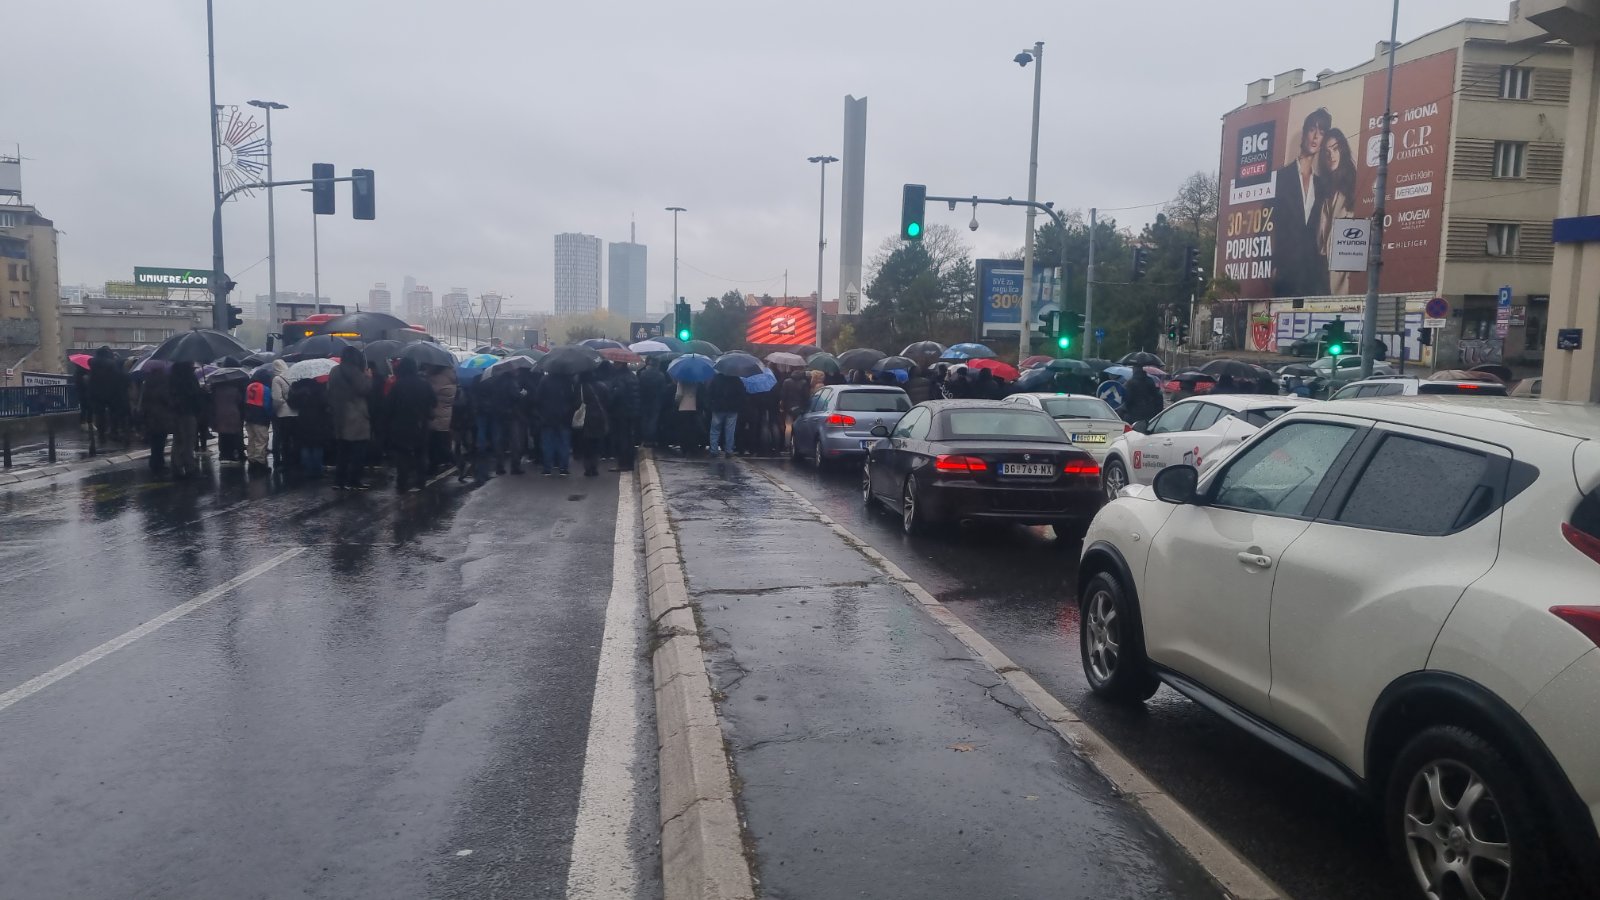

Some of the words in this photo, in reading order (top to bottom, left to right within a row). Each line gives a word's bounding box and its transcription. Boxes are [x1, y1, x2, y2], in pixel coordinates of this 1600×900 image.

[1369, 112, 1398, 130] BOS
[1404, 102, 1438, 122] MONA
[1241, 132, 1268, 155] BIG
[1402, 125, 1432, 149] C.P.
[1241, 153, 1268, 164] FASHION
[1396, 144, 1434, 160] COMPANY
[1241, 164, 1265, 176] OUTLET
[1396, 171, 1417, 183] Calvin
[1417, 169, 1434, 180] Klein
[1227, 206, 1274, 236] 30-70%
[1398, 209, 1430, 222] MOVEM
[1226, 235, 1272, 260] POPUSTA
[1395, 239, 1428, 249] HILFIGER
[1225, 262, 1249, 280] SVAKI
[1252, 260, 1272, 279] DAN
[139, 272, 208, 285] UNIVEREXPOR
[1501, 290, 1508, 304] P
